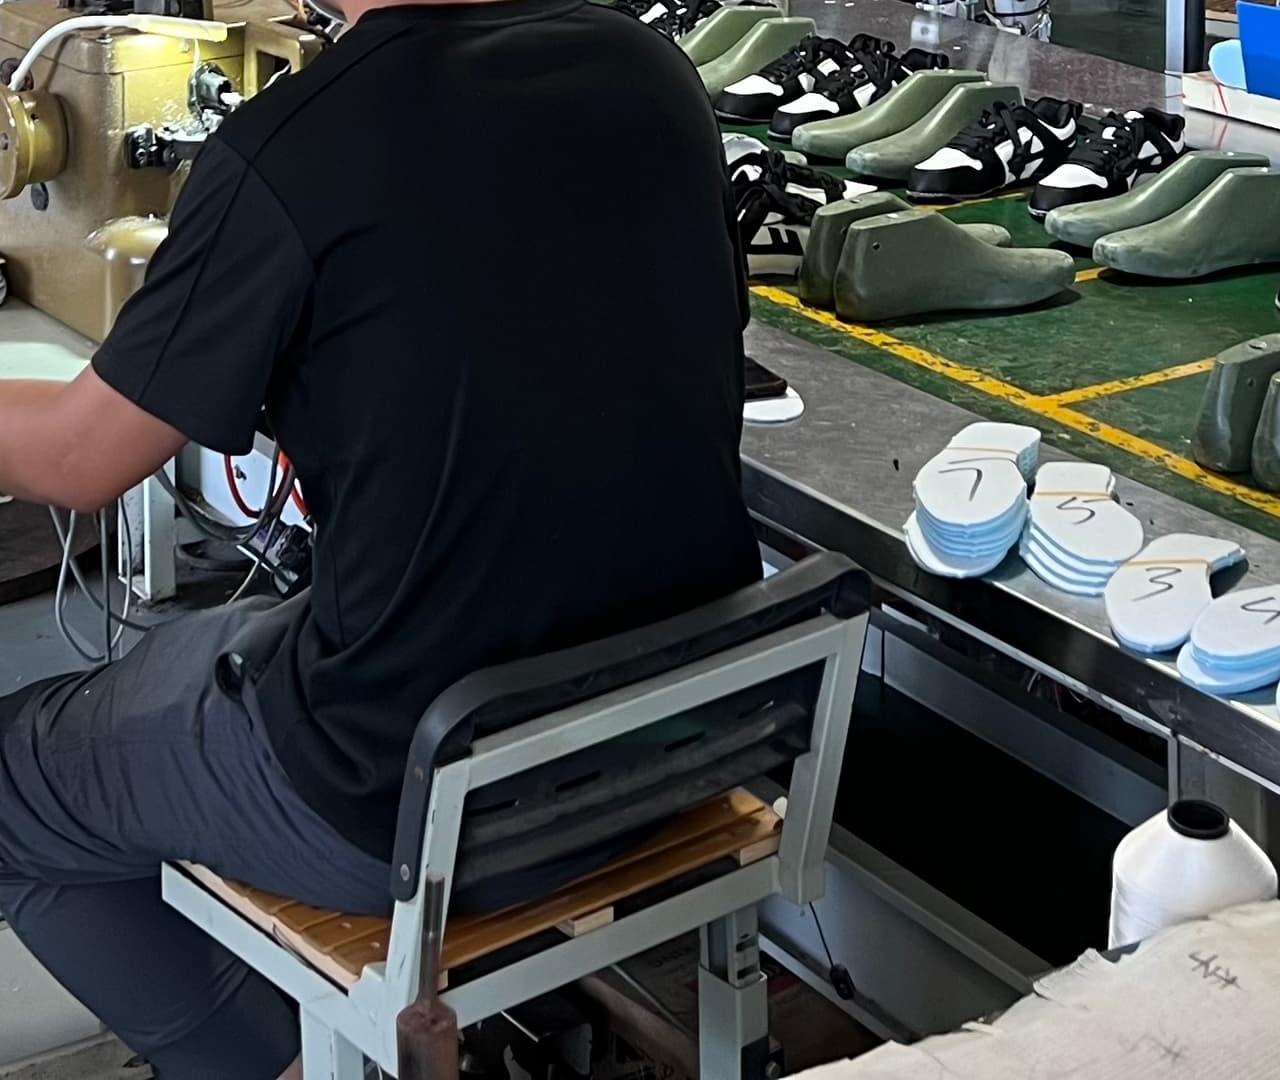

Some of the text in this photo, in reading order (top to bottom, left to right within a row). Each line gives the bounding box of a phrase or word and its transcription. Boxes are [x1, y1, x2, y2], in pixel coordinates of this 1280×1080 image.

[937, 455, 982, 502] 7
[1053, 495, 1099, 526] 5
[1132, 564, 1182, 602] 3
